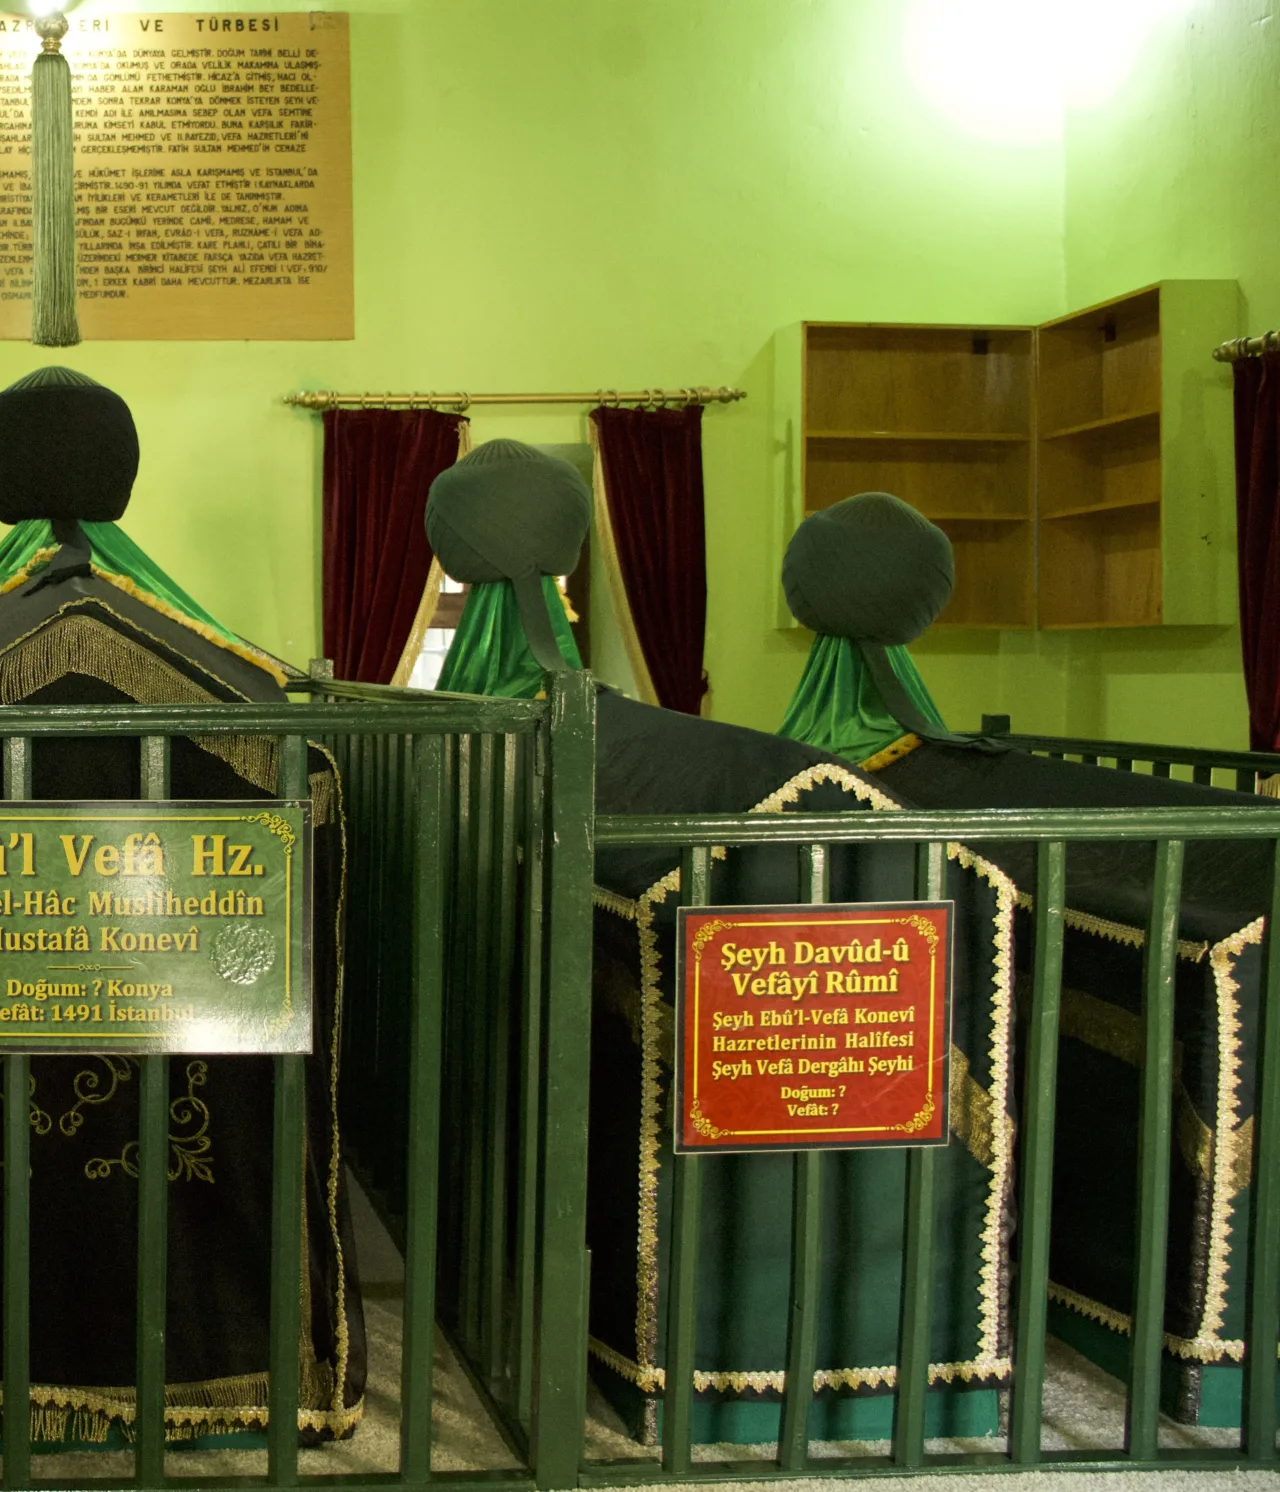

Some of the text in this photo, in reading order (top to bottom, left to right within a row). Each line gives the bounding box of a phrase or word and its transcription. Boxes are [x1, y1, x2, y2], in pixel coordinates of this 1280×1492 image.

[139, 18, 164, 33] VE
[195, 17, 280, 33] TÜRBESİ
[152, 61, 198, 71] VE ORADA
[89, 85, 116, 95] HABER
[258, 84, 275, 94] BEY
[98, 97, 125, 106] SONRA
[129, 96, 161, 106] TEKRAR
[103, 109, 117, 119] ADI
[192, 108, 219, 118] SEBEP
[222, 108, 246, 118] OLAN
[251, 108, 273, 118] VEFA
[139, 121, 167, 130] KABUL
[221, 120, 244, 130] BUNA
[87, 133, 117, 143] SULTAN
[121, 133, 156, 143] MEHMED
[160, 133, 172, 143] VE
[221, 133, 243, 142] VEFA
[193, 144, 222, 153] SULTAN
[170, 168, 192, 178] ASLA
[249, 168, 261, 177] VE
[2, 182, 14, 192] VE
[186, 180, 211, 190] VEFAT
[130, 193, 142, 203] VE
[220, 192, 232, 202] DE
[95, 203, 109, 215] BİR
[141, 205, 176, 215] MEVCUT
[262, 216, 293, 226] HAMAM
[297, 216, 309, 226] VE
[196, 241, 218, 251] KARE
[160, 277, 183, 287] DAHA
[60, 832, 165, 876] Vefâ
[191, 835, 264, 876] Hz.
[89, 890, 264, 916] Musliheddîn
[100, 927, 198, 951] Konevî
[721, 938, 909, 971] Şeyh Davûd-û
[7, 979, 173, 1000] Doğum: ? Konya
[731, 969, 899, 1001] Vefâyî Rûmî
[51, 1004, 103, 1021] 1491
[109, 1000, 195, 1021] İstanbul
[713, 1006, 914, 1031] Şeyh Ebû'l-Vefâ Konevî
[713, 1031, 914, 1052] Hazretlerinin Halîfesi
[712, 1056, 913, 1080] Şeyh Vefâ Dergâhı Şeyhi
[781, 1085, 846, 1101] Doğum: ?
[787, 1104, 839, 1116] Vefât: ?
